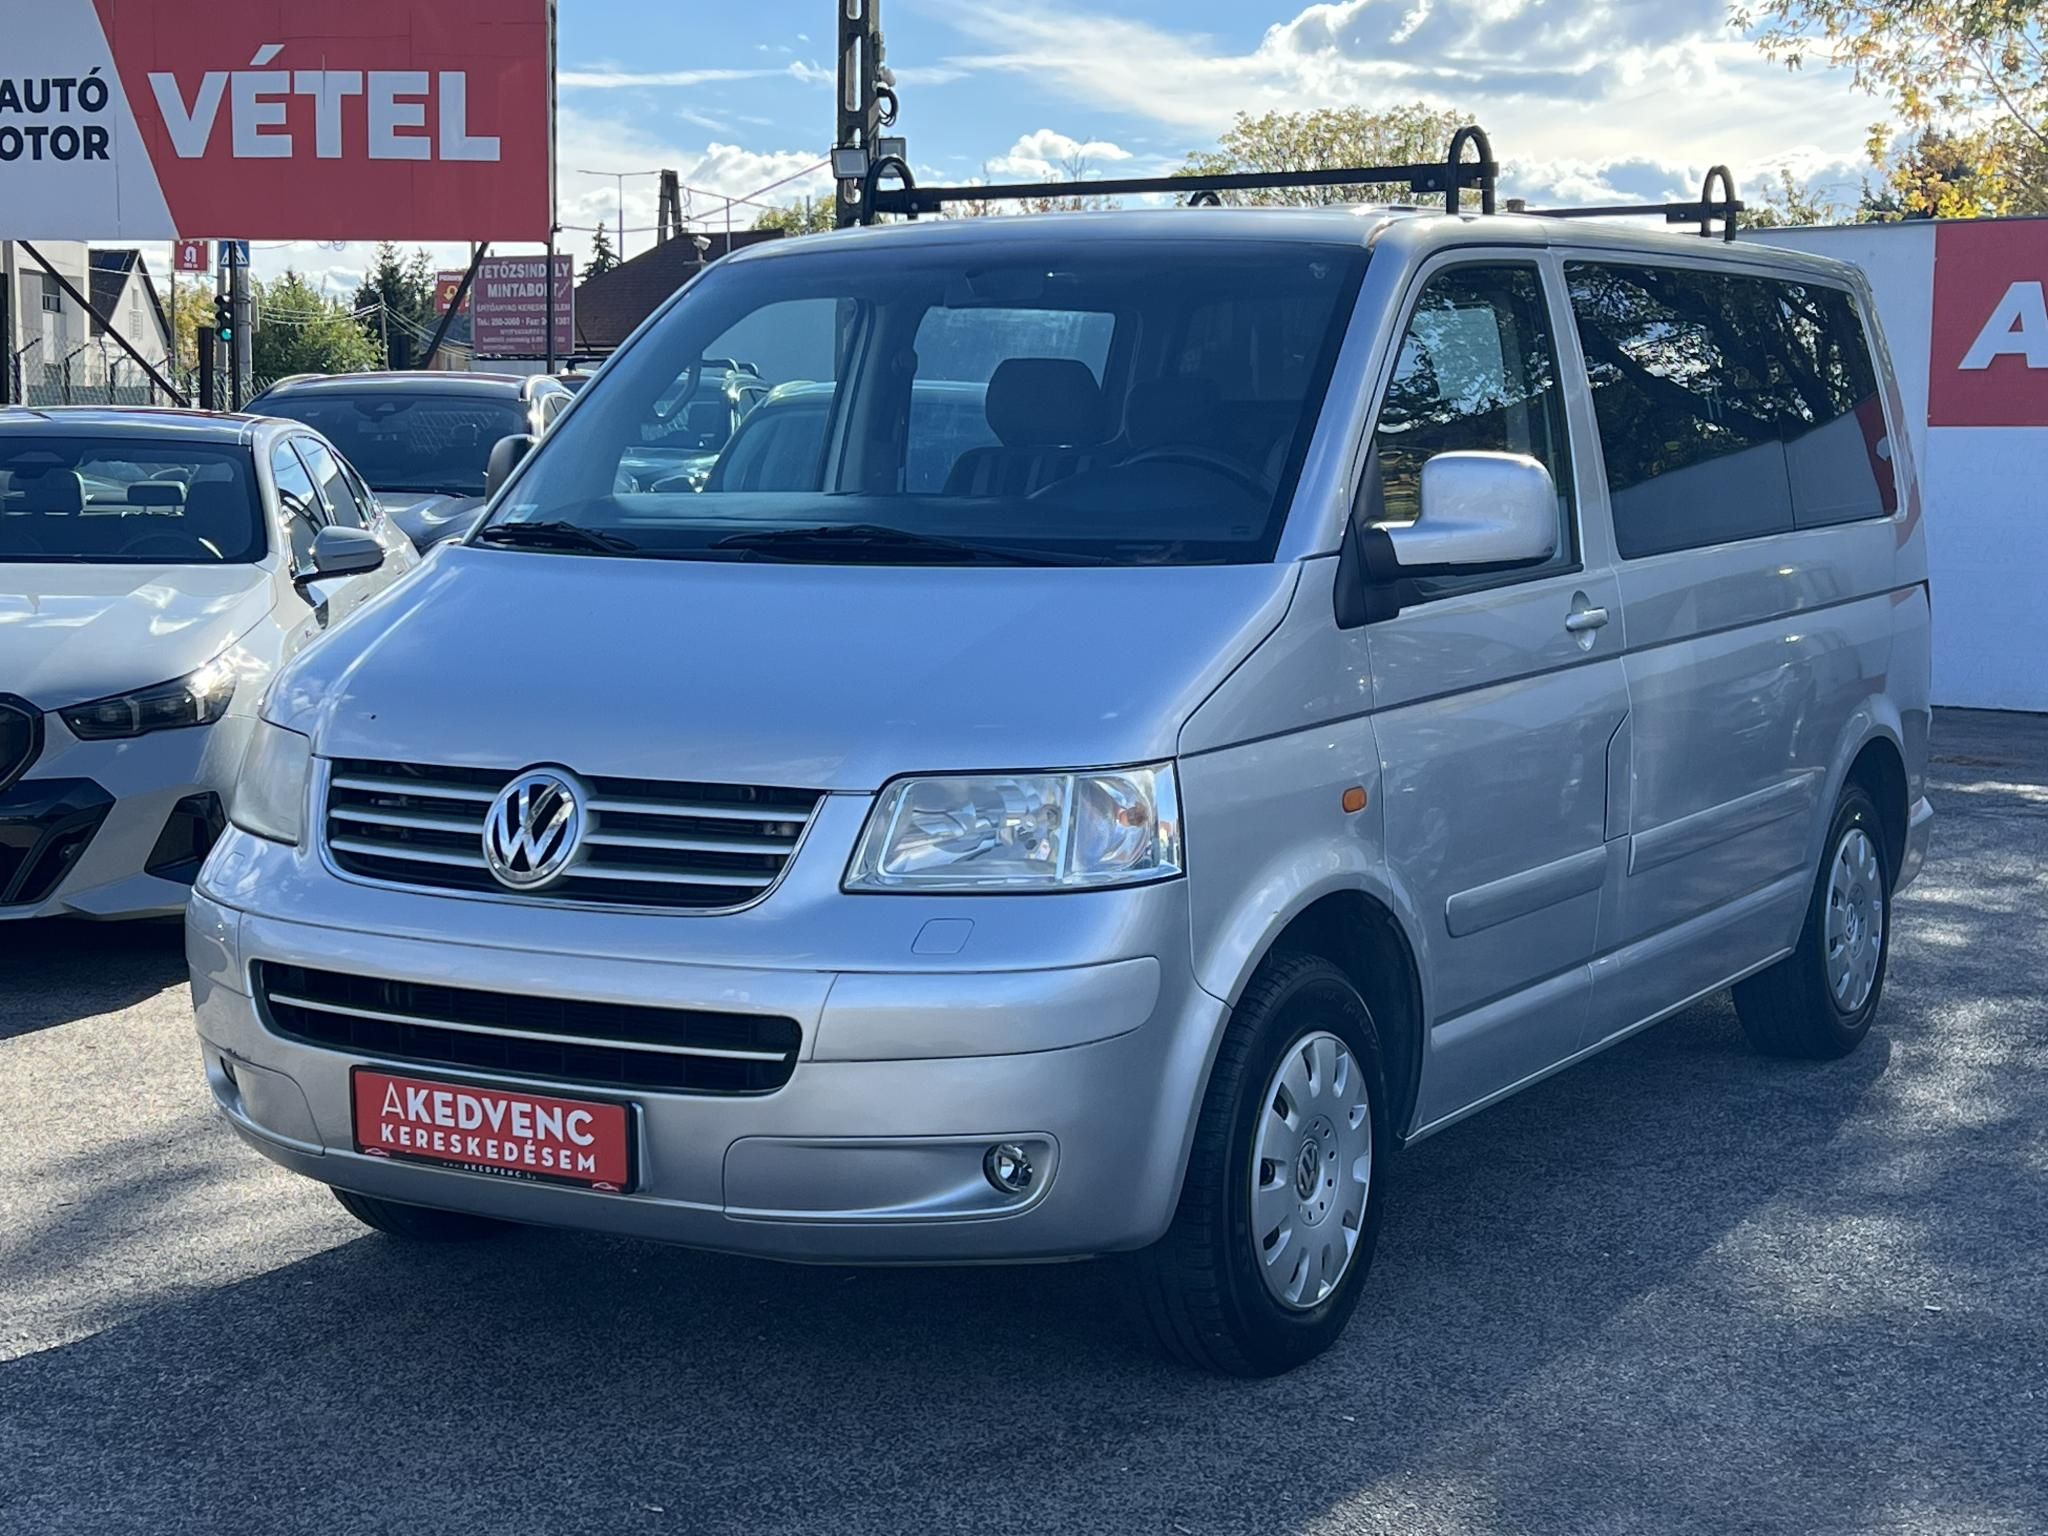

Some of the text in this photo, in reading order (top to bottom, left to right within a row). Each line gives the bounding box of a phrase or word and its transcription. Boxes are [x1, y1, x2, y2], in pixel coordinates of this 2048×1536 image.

[0, 66, 108, 113] AUTÓ
[147, 44, 501, 161] VÉTEL
[478, 261, 569, 279] TETŐZSINDLY
[1957, 281, 2048, 369] A
[489, 772, 578, 880] VW
[381, 1123, 596, 1173] KERESKEDÉSEM
